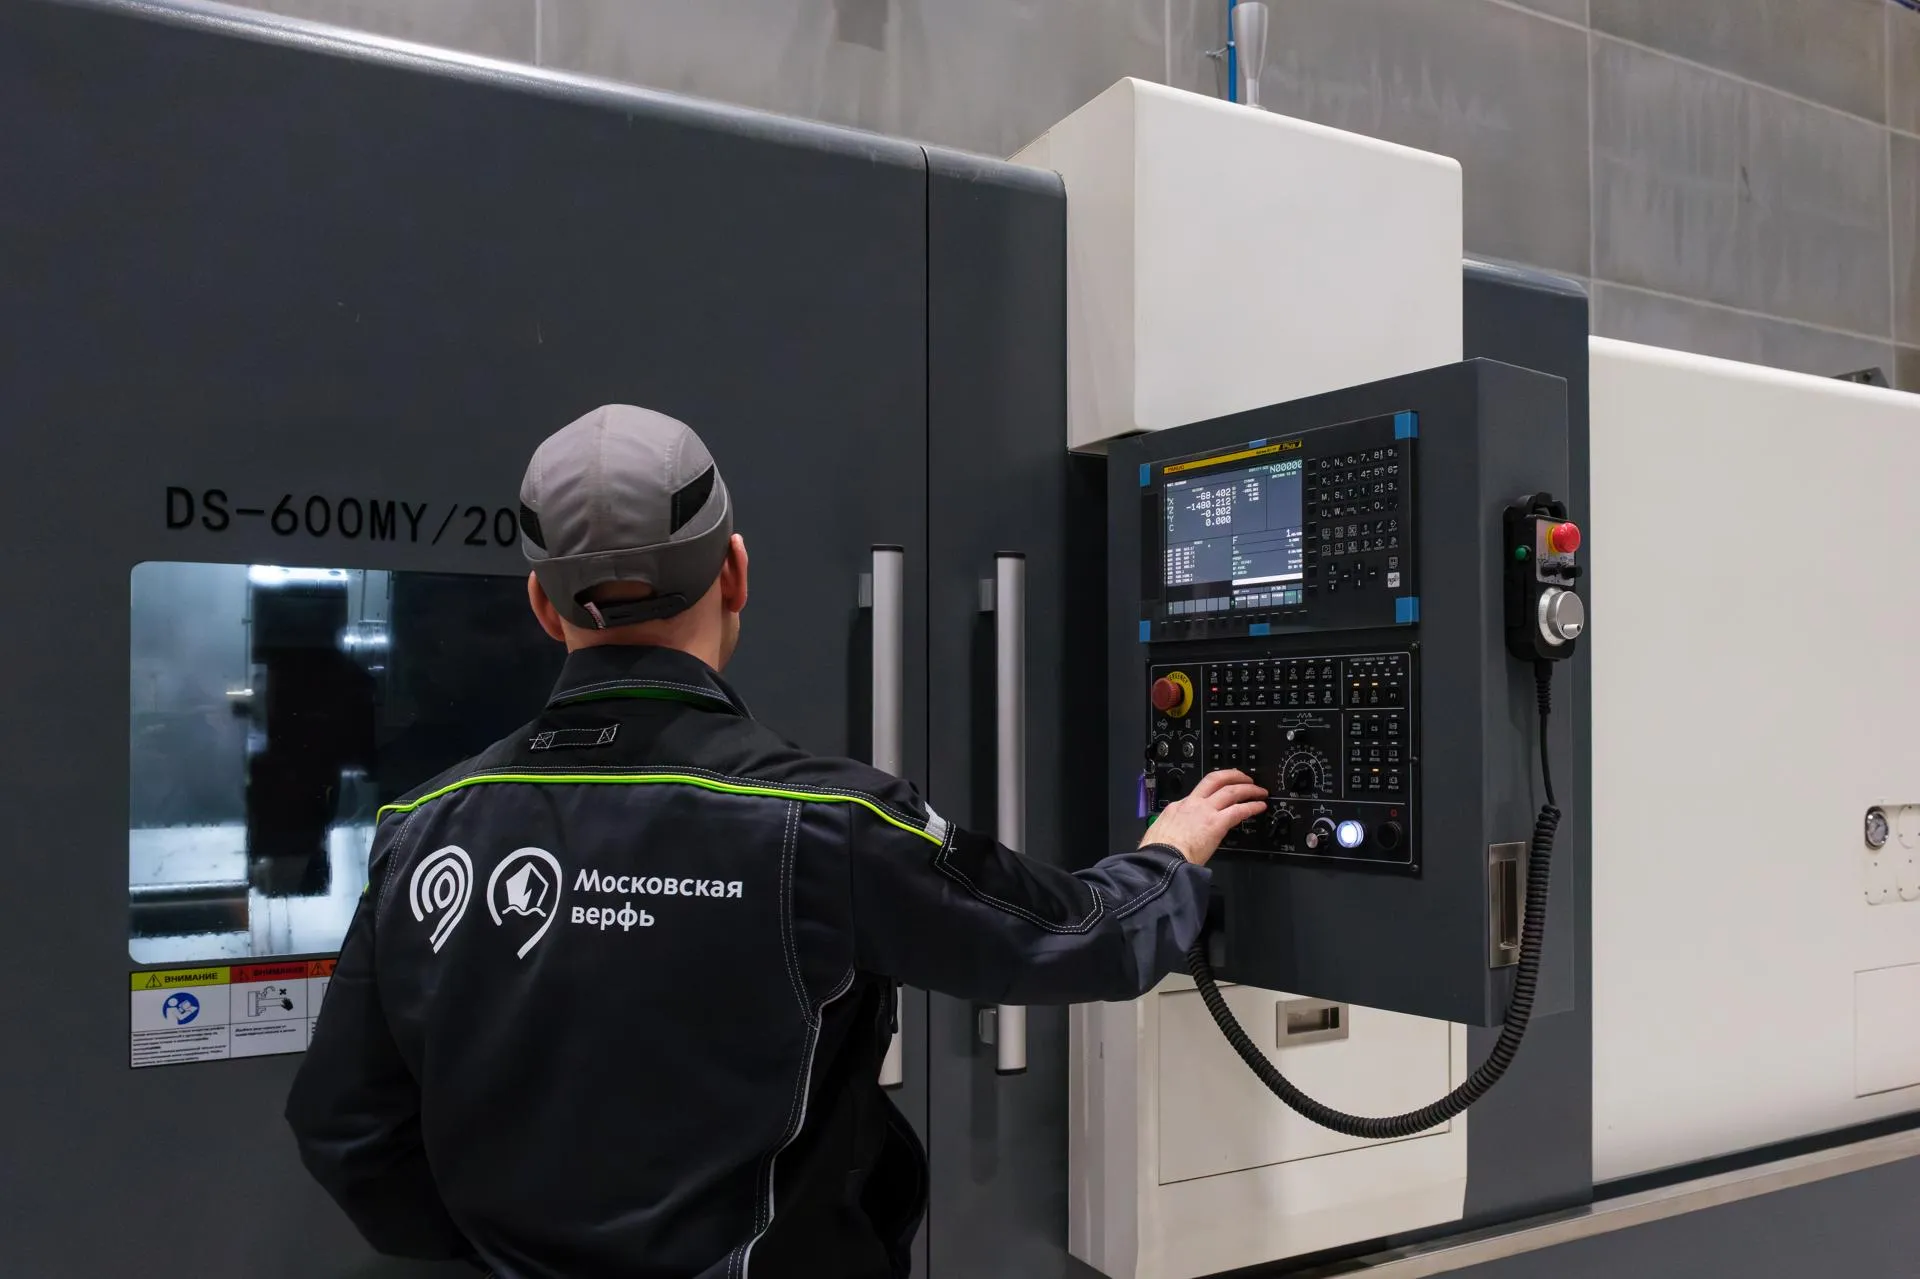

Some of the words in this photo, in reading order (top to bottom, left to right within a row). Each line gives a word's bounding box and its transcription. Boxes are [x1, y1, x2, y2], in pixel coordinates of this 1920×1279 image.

[166, 486, 518, 548] DS-600MY/20
[573, 868, 743, 898] Московская
[571, 902, 655, 932] верфь
[164, 972, 218, 983] ВНИМАНИЕ
